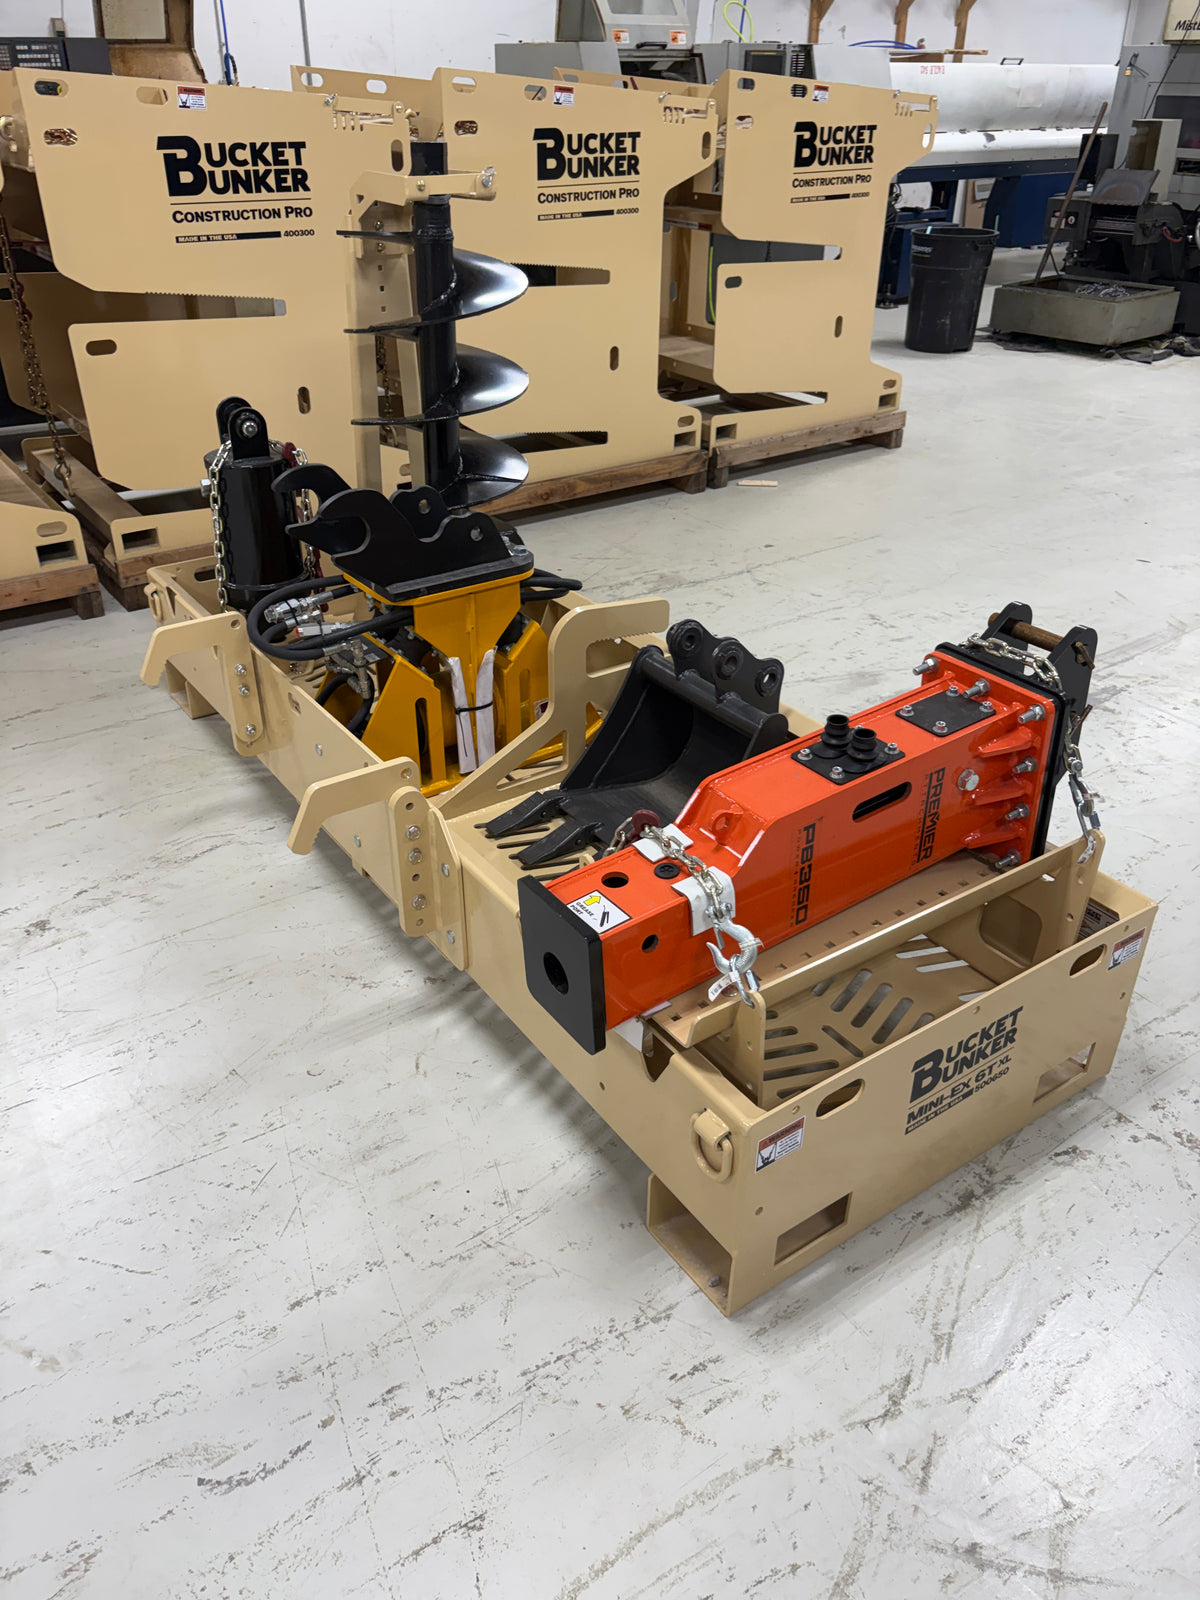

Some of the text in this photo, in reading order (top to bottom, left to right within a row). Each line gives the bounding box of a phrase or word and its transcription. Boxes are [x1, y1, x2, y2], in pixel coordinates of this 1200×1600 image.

[533, 127, 641, 157] BUCKET
[793, 121, 877, 147] BUCKET
[156, 135, 307, 170] BUCKET
[793, 144, 874, 168] BUNKER
[536, 153, 640, 181] BUNKER
[161, 166, 311, 197] BUNKER
[792, 174, 872, 188] CONSTRUCTION PRO
[537, 187, 640, 204] CONSTRUCTION PRO
[172, 205, 313, 224] CONSTRUCTION PRO
[616, 207, 639, 215] 400300
[178, 235, 199, 243] MADE
[223, 233, 238, 241] USA
[283, 229, 315, 237] 400300
[921, 766, 946, 861] PREMIER
[795, 822, 816, 926] PB350
[570, 904, 584, 915] PORT
[575, 901, 595, 917] GREASE
[911, 1005, 1024, 1070] BUCKET
[909, 1027, 1018, 1104] BUNKER
[906, 1078, 971, 1125] MINI-EX
[997, 1054, 1012, 1068] XL
[974, 1066, 1010, 1092] 500650
